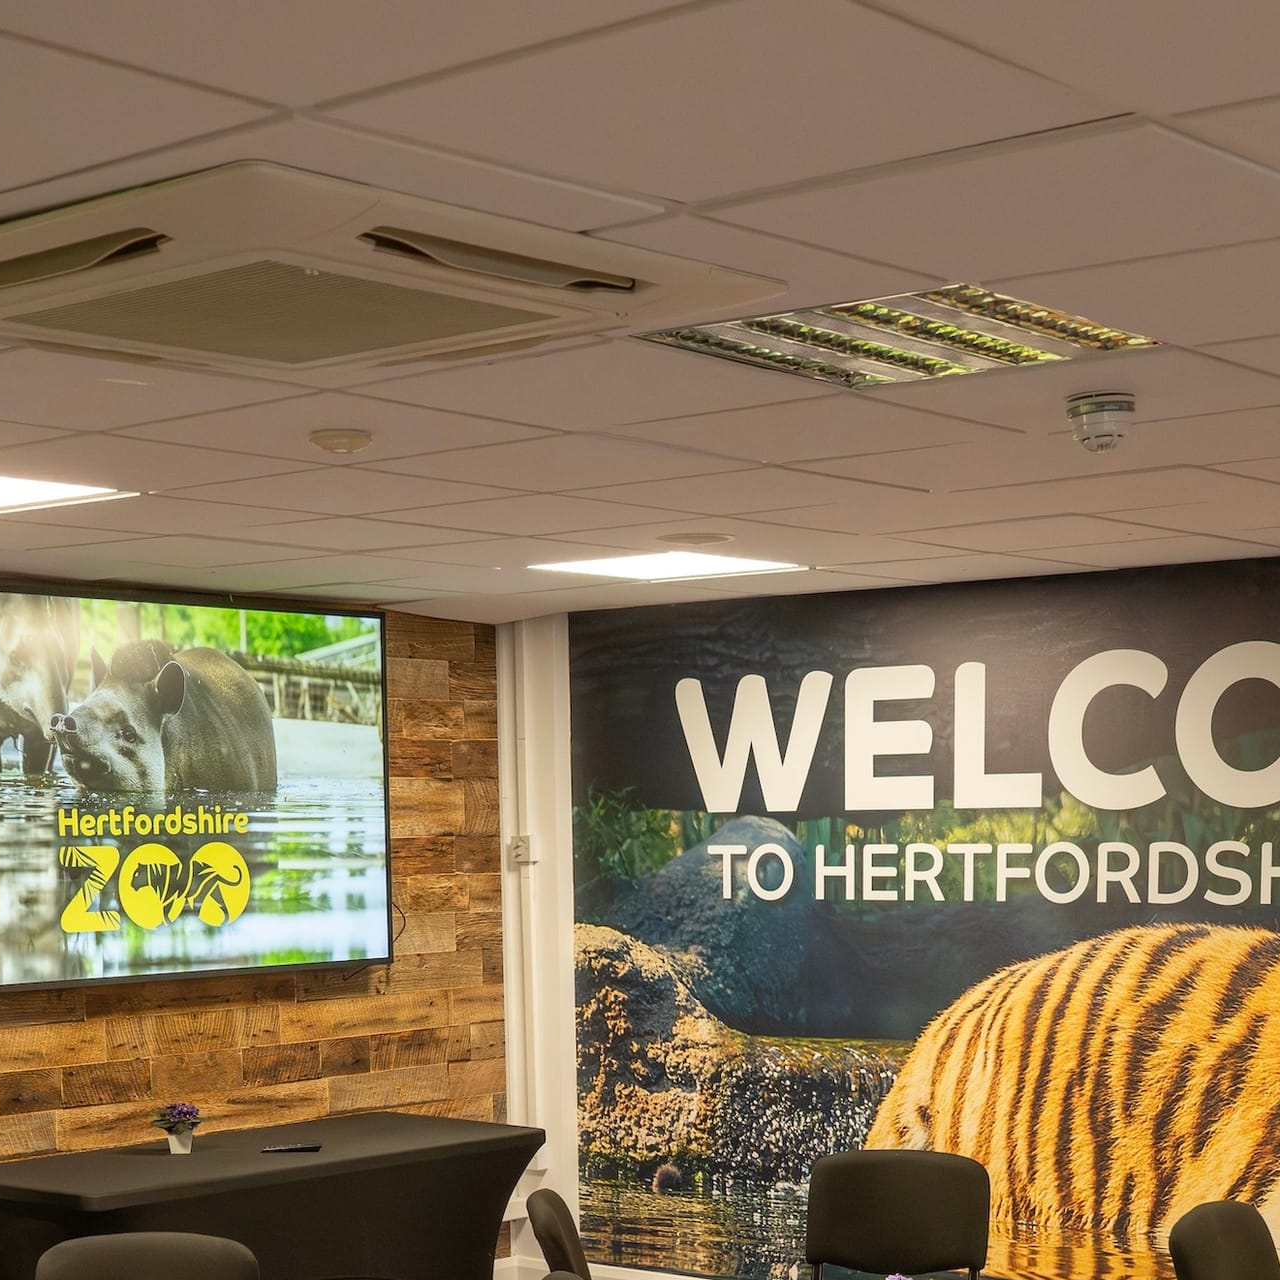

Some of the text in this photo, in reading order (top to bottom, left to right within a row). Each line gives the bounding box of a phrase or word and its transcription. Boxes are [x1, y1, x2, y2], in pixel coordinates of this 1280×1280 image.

[58, 806, 249, 837] Hertfordshire
[59, 842, 251, 933] ZOO
[708, 843, 795, 902] TO
